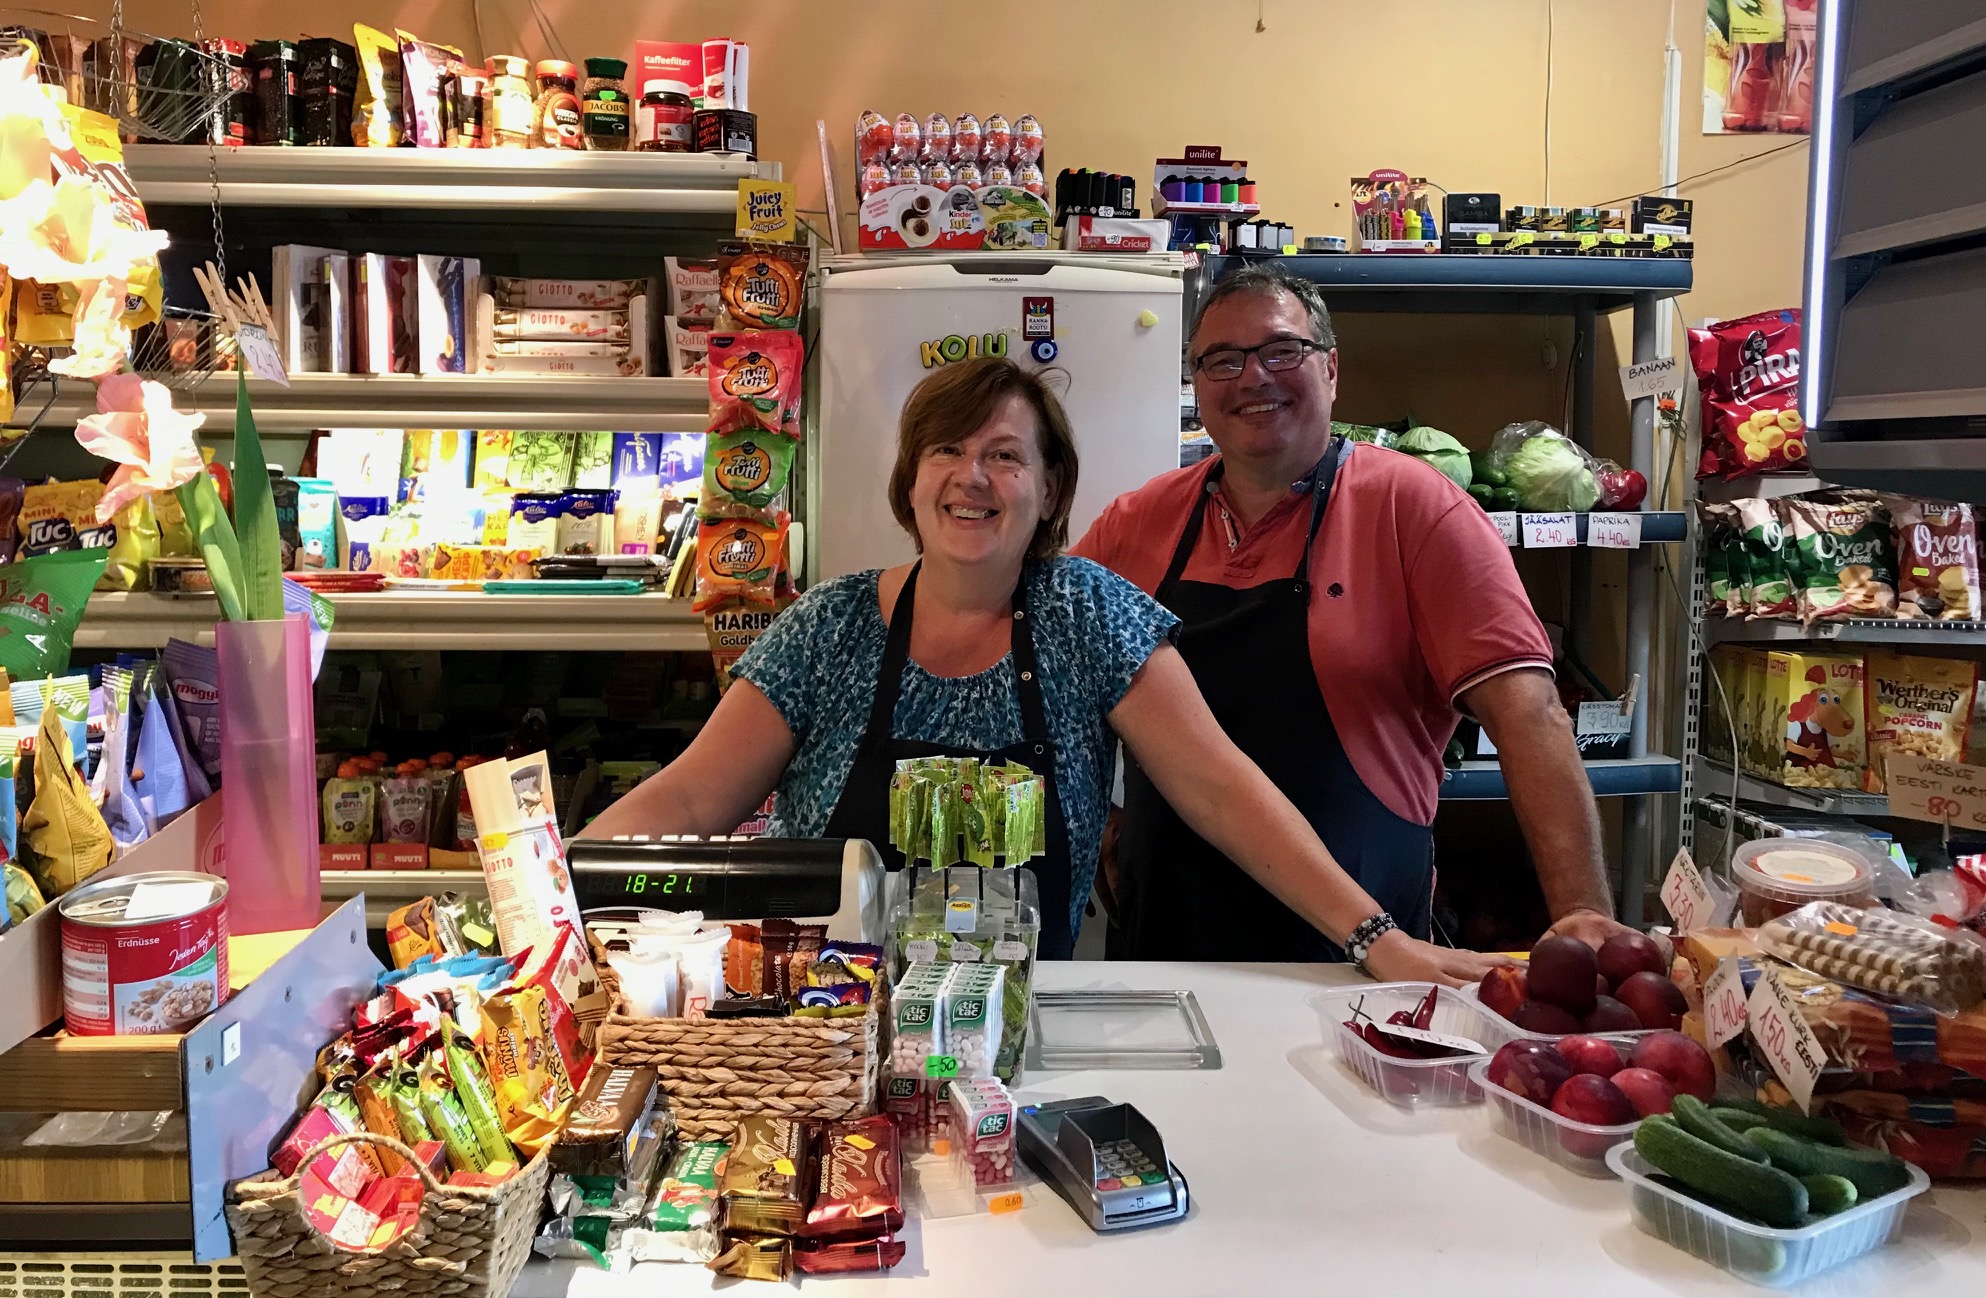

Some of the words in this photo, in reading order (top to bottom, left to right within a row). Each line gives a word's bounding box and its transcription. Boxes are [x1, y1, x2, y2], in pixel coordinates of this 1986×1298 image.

[643, 55, 691, 66] Kaffeefilter
[589, 102, 625, 112] JACOBS
[1189, 151, 1215, 159] unilite
[747, 191, 782, 207] Juicy
[750, 205, 783, 221] Fruit
[751, 221, 769, 233] Jelly
[768, 219, 787, 231] Chews
[1122, 239, 1149, 249] Cricket
[538, 283, 573, 295] GIOTTO
[746, 277, 779, 294] Tutti
[742, 288, 780, 307] Frutti
[530, 313, 566, 325] GIOTTO
[676, 332, 708, 347] Raffa
[549, 362, 574, 371] GIOTTO
[738, 366, 770, 380] Tutti
[1628, 358, 1676, 379] BANAAN
[1638, 375, 1667, 392] 1.65
[23, 507, 56, 520] MINI
[1524, 515, 1572, 525] JÄÄSALAT
[1592, 514, 1630, 525] PAPRIKA
[30, 521, 67, 546] TUC
[79, 529, 114, 549] TUC
[1536, 527, 1562, 543] 2.40
[1597, 527, 1622, 545] 4.40
[1913, 523, 1975, 558] Oven
[723, 541, 756, 553] Ttti
[1814, 532, 1883, 559] Oven
[717, 551, 756, 564] Frutti
[1835, 554, 1873, 567] Baked
[1931, 552, 1966, 567] Baked
[312, 598, 330, 625] NEW
[1769, 659, 1788, 673] LOTTE
[1876, 678, 1960, 702] Werther's
[51, 687, 88, 716] NEW
[1894, 696, 1954, 714] Original
[1884, 716, 1943, 730] POPCORN
[1895, 774, 1942, 791] EESTI
[1951, 784, 1986, 797] KART
[733, 817, 767, 834] mall
[332, 853, 361, 861] MUUTI
[117, 936, 160, 948] Erdnüsse
[168, 946, 196, 970] Jeden
[910, 1004, 927, 1015] tic
[958, 1007, 978, 1017] tac
[962, 1000, 979, 1011] tic
[905, 1012, 926, 1022] tac
[129, 1025, 147, 1035] 200
[1789, 1008, 1812, 1047] KURK
[1795, 1038, 1823, 1081] EESTI
[892, 1085, 912, 1095] tac
[897, 1078, 912, 1088] tic
[988, 1115, 1004, 1126] tic
[982, 1123, 1003, 1133] tac
[1005, 1195, 1022, 1207] 0.60
